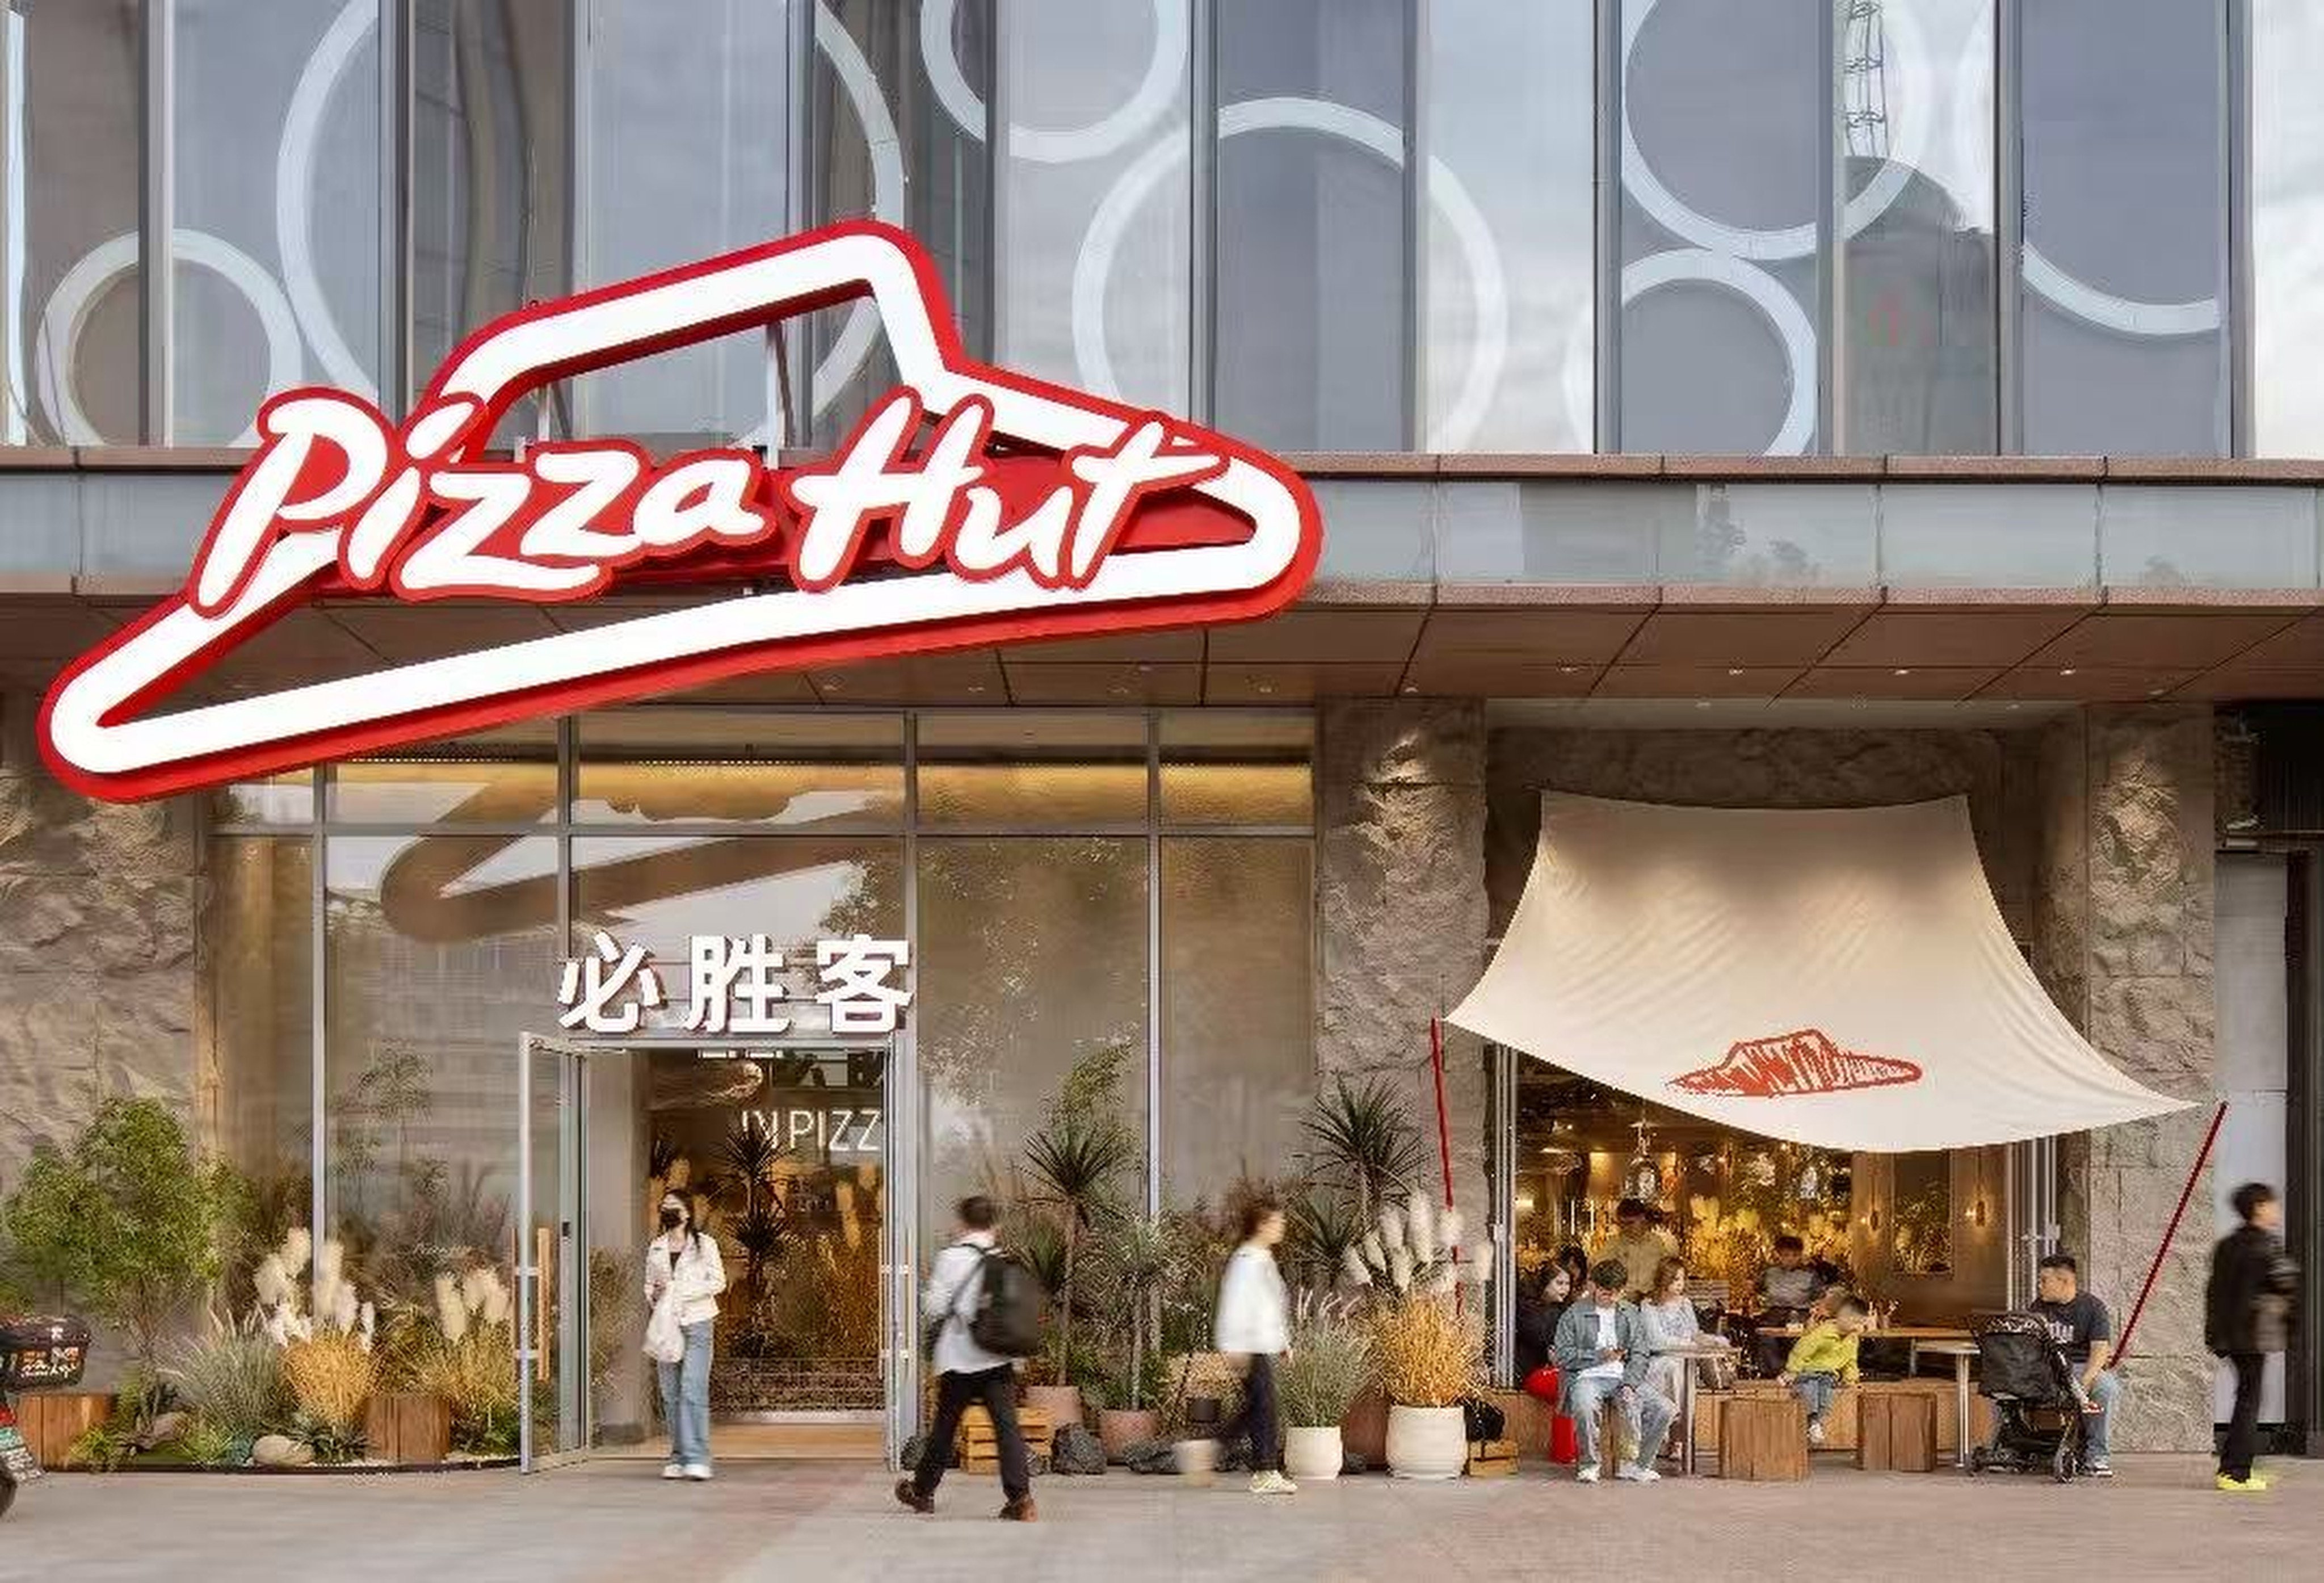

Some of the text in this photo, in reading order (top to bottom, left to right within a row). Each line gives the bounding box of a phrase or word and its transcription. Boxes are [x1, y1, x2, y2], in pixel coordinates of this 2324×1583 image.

[197, 395, 1222, 607] Pizza Hut
[557, 931, 913, 1034] 必胜客
